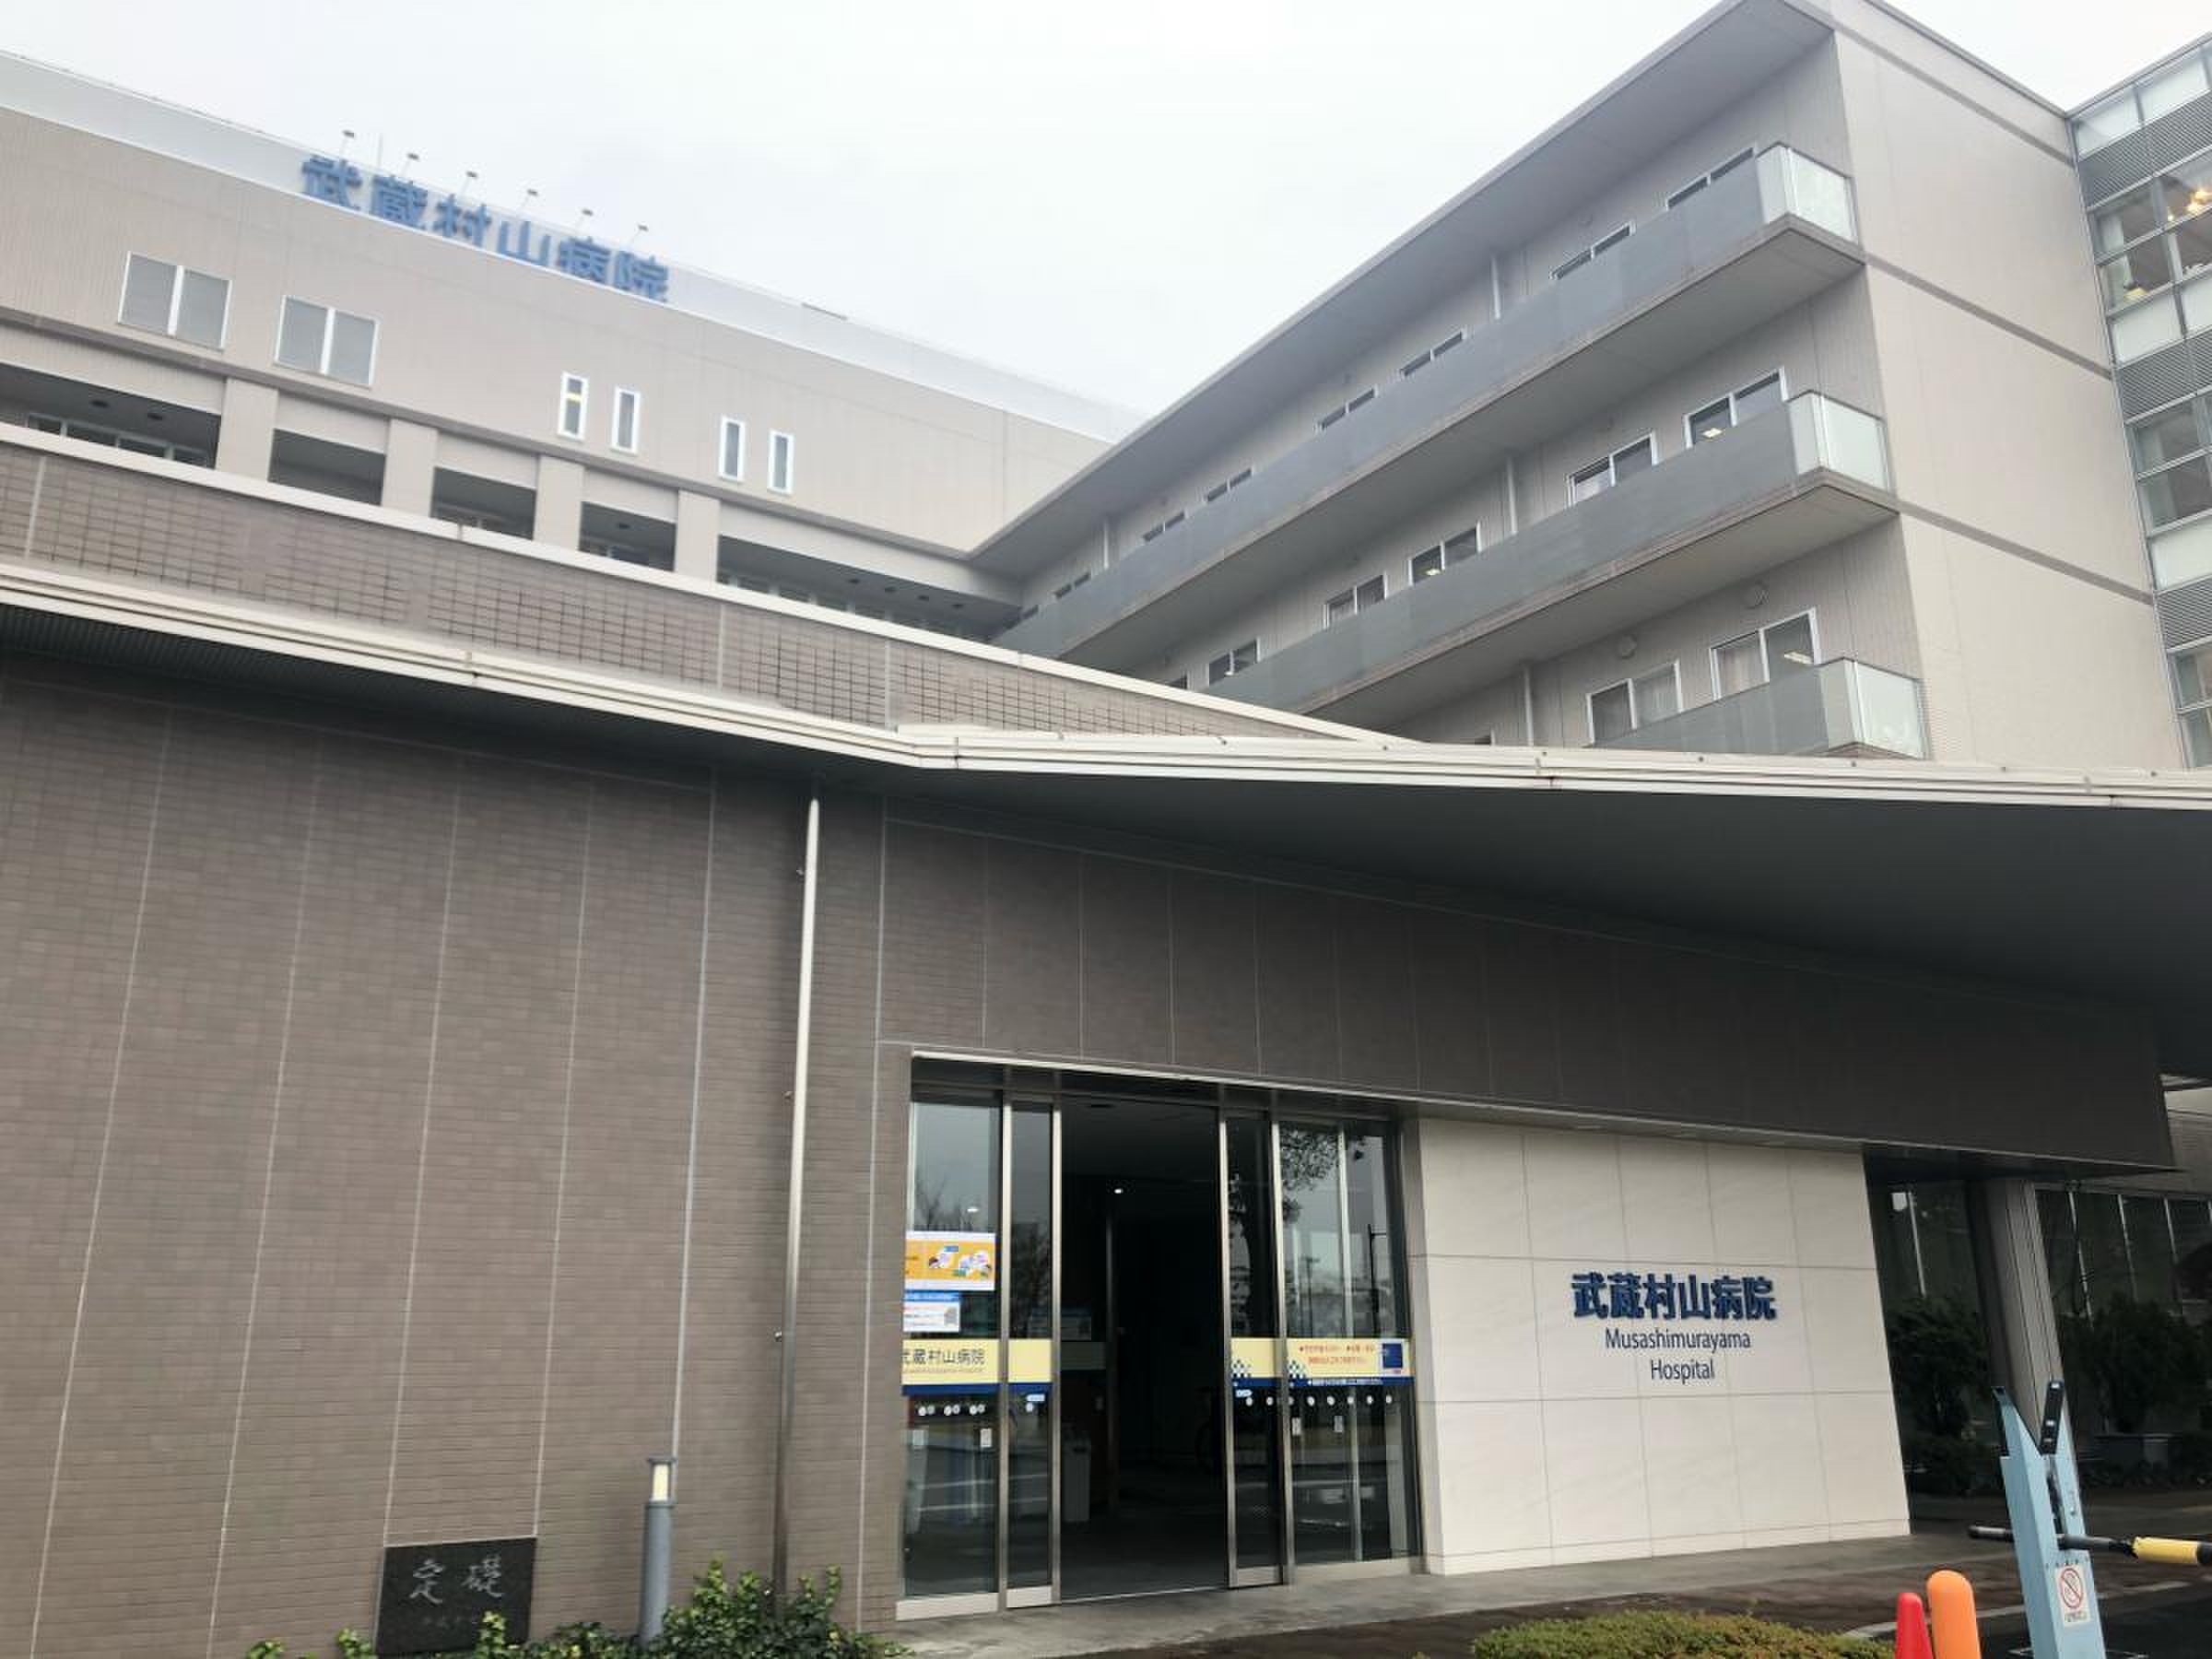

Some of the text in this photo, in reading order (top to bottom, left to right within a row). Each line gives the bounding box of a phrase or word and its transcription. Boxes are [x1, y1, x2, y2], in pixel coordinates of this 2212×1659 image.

[301, 153, 670, 303] 武蔵村山病院
[1571, 1272, 1778, 1320] 武蔵村山病院
[1605, 1327, 1752, 1353] Musashimurayama
[1650, 1359, 1715, 1384] Hospital
